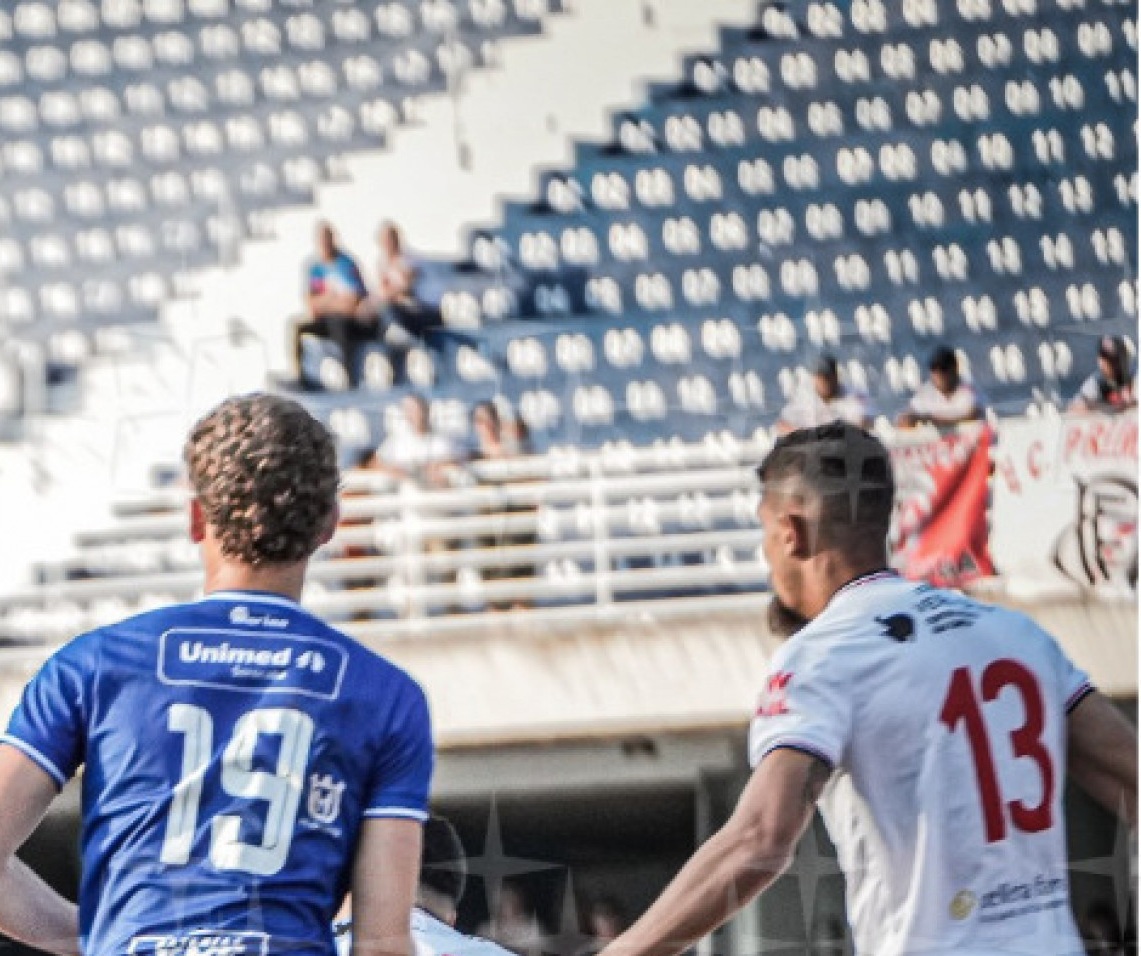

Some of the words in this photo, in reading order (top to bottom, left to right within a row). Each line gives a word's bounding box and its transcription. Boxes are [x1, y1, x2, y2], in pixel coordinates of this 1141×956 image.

[179, 640, 293, 666] Unimed
[159, 703, 315, 877] 19
[939, 657, 1055, 843] 13
